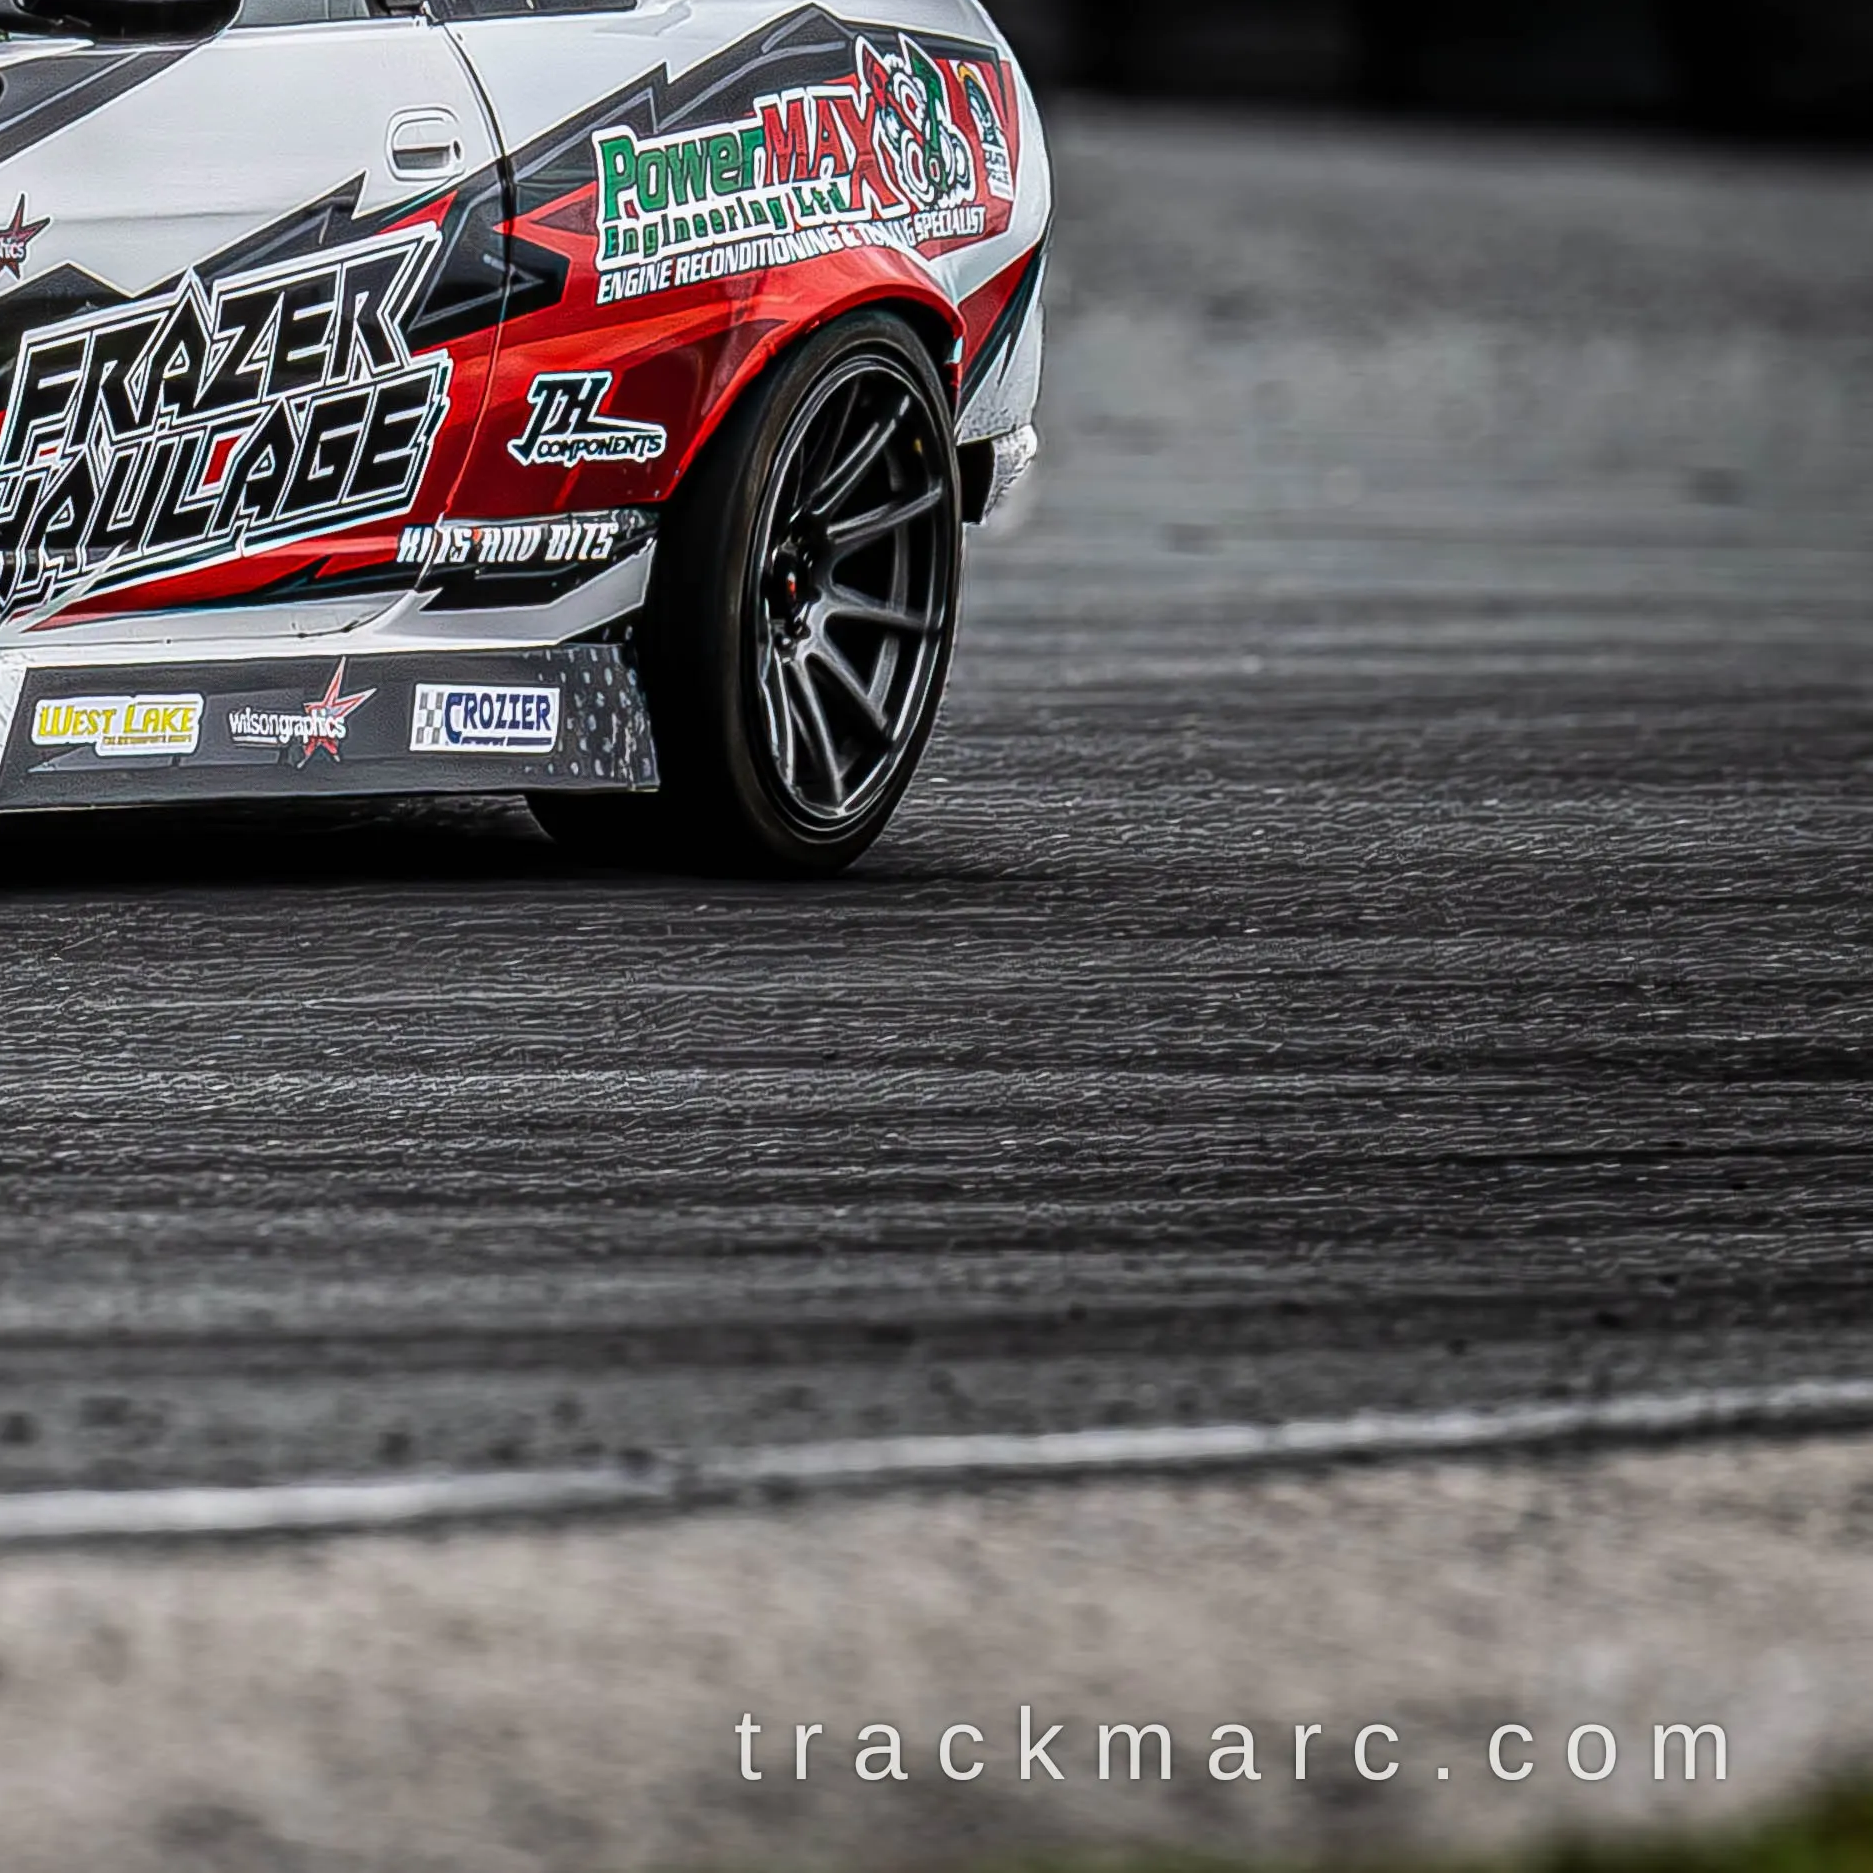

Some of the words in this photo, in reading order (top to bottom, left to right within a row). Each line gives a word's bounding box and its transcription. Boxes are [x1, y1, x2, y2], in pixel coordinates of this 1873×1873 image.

[603, 197, 787, 260] Engineering
[597, 265, 671, 305] ENGINE
[674, 228, 839, 284] RECONDITIONING
[537, 434, 663, 462] COMPONENTS
[396, 525, 473, 564] KITS
[478, 525, 543, 564] AND
[544, 523, 619, 562] BITS
[123, 704, 197, 734] LAKE
[229, 707, 347, 742] wilsongraphics
[444, 692, 552, 744] CROZIER
